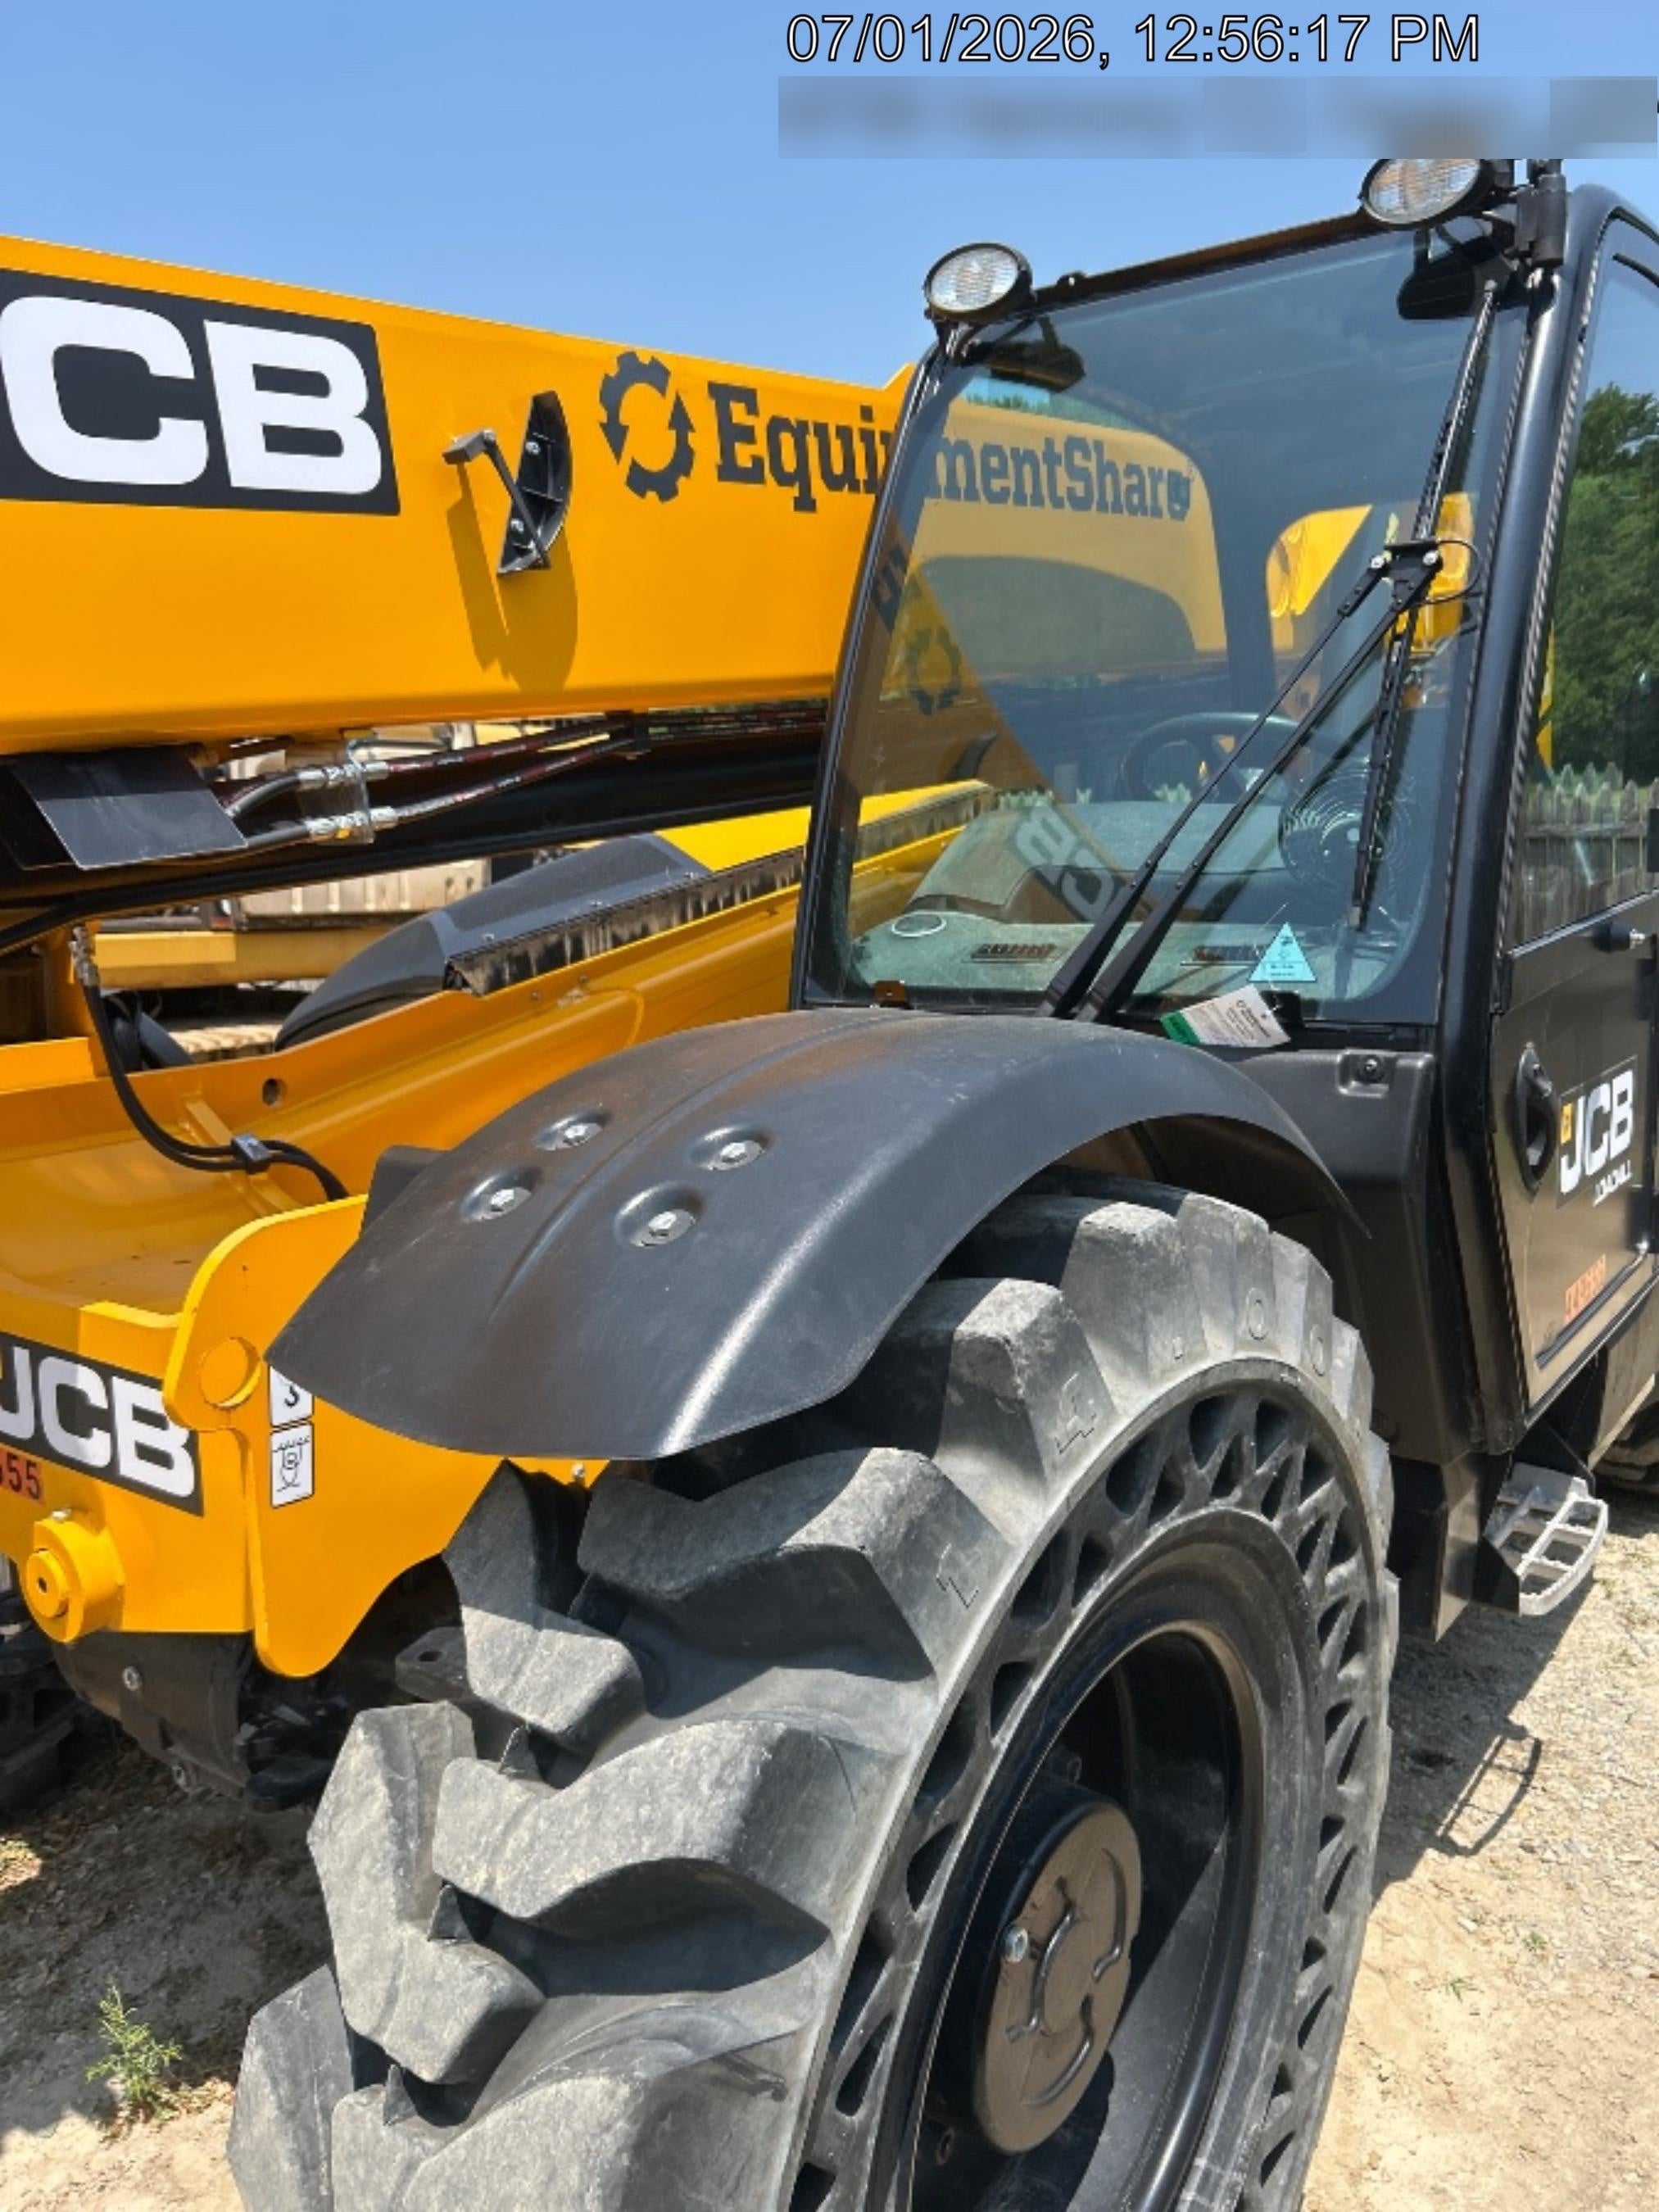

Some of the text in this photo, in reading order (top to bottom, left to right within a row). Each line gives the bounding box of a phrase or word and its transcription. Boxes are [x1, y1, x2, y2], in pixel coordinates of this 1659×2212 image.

[1561, 1070, 1634, 1194] JCB
[0, 1346, 194, 1499] JCB
[0, 1453, 40, 1500] 55
